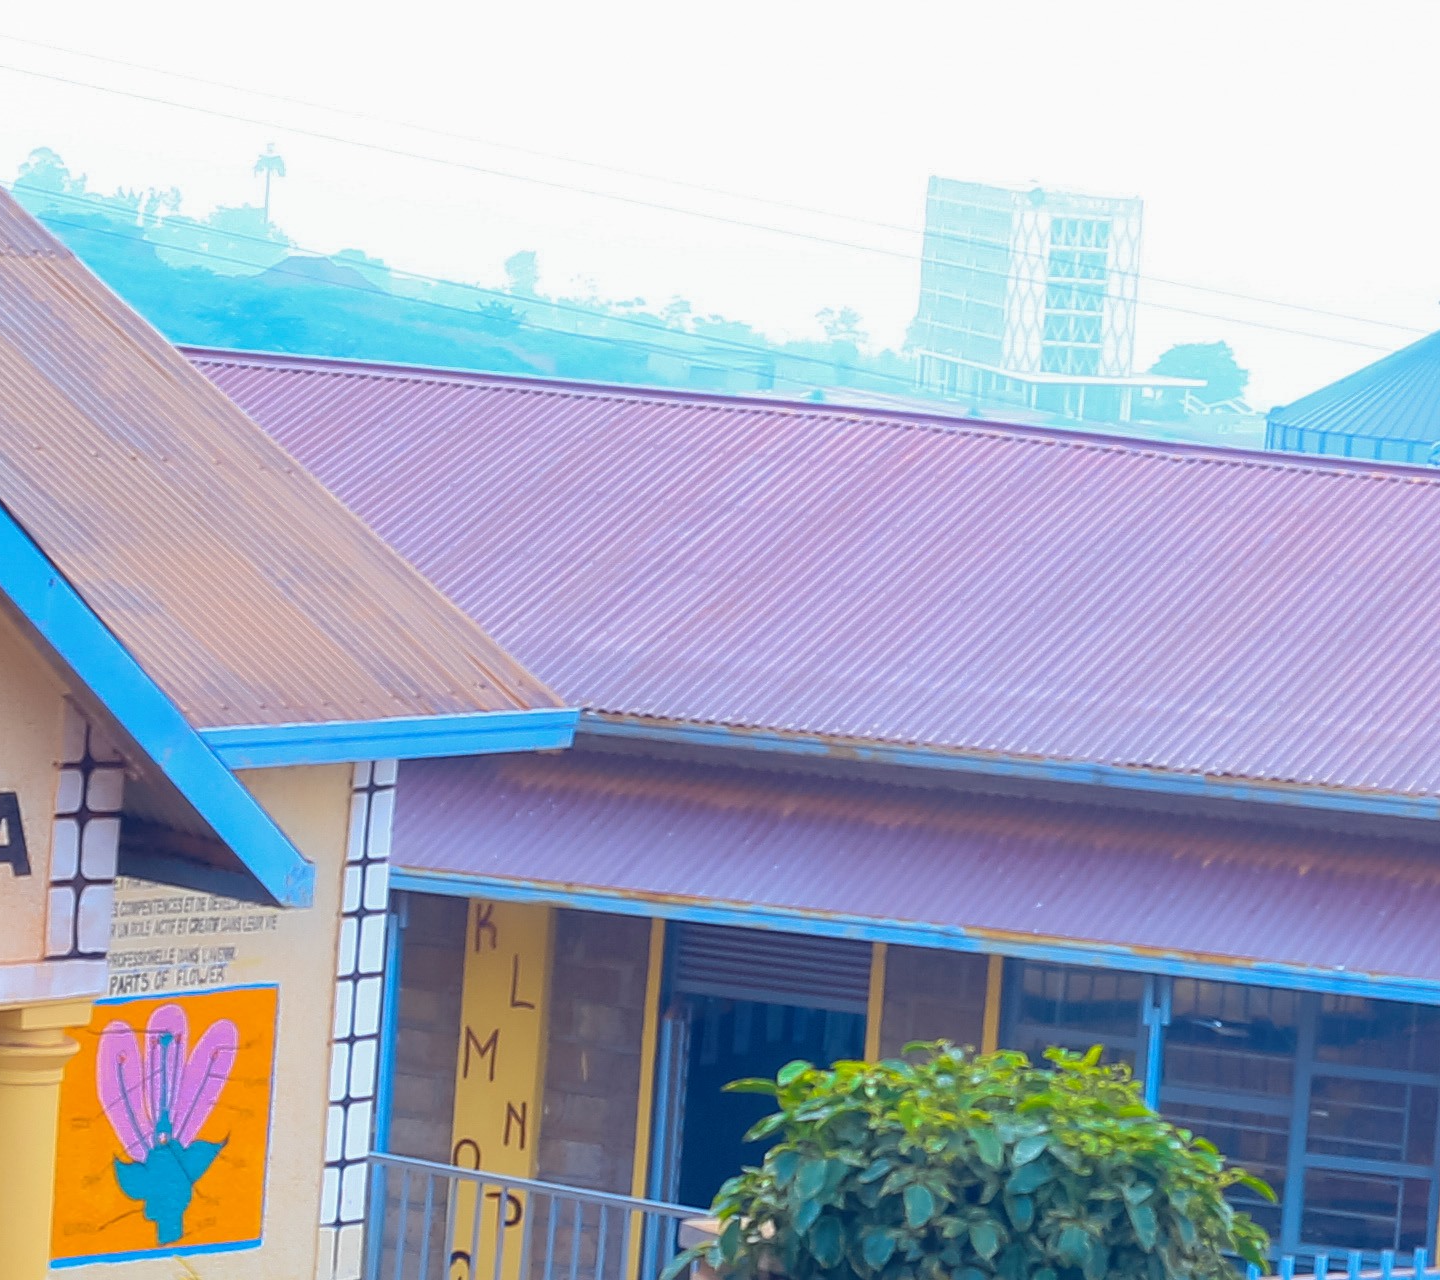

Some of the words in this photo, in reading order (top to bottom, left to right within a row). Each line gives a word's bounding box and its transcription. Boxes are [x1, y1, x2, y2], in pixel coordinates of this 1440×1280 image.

[474, 902, 497, 954] K
[109, 972, 148, 996] PARTS
[153, 969, 169, 990] OF
[176, 965, 225, 986] FLOWER
[509, 953, 535, 1010] L
[462, 1024, 500, 1083] M
[503, 1101, 527, 1151] N
